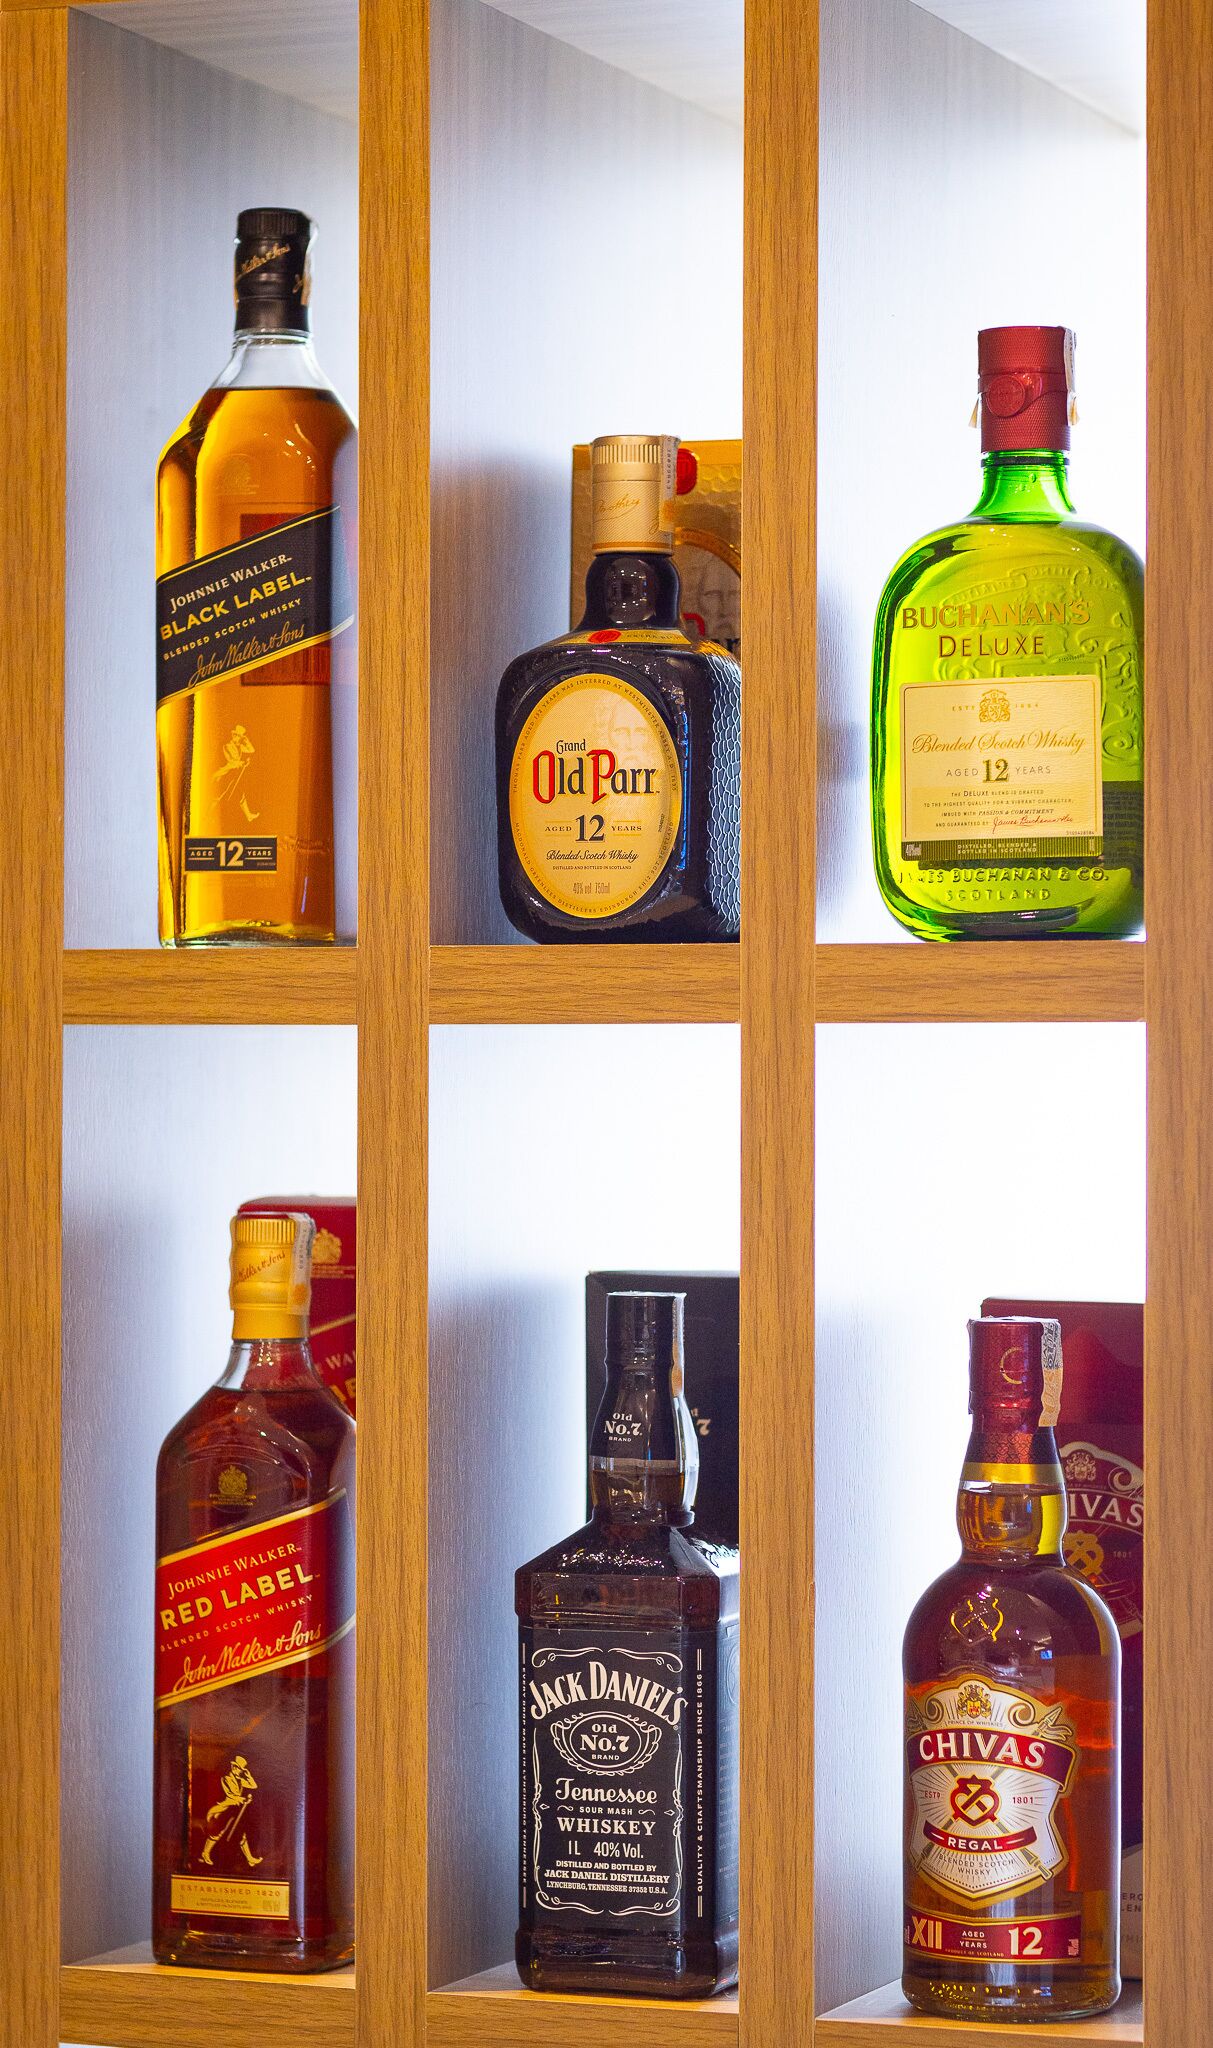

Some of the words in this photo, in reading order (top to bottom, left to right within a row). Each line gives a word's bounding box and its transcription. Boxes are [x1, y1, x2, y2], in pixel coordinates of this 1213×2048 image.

[170, 577, 231, 614] JOHNNIE
[230, 554, 288, 583] WALKER
[160, 599, 231, 640] BLACK
[233, 571, 306, 610] LABEL
[902, 600, 1092, 630] BUCHANAN'S
[163, 634, 211, 661] BLENDED
[214, 616, 256, 640] SCOTCH
[260, 598, 302, 620] WHISKY
[187, 653, 223, 688] John
[223, 637, 268, 668] Walker
[556, 739, 586, 755] Grand
[911, 733, 976, 754] Blended
[976, 731, 1026, 753] Scotch
[1027, 728, 1087, 756] Whisky
[532, 750, 586, 805] Old
[586, 749, 658, 805] Parr
[946, 768, 979, 778] AGED
[981, 758, 1010, 783] 12
[1015, 765, 1052, 775] YEARS
[574, 813, 606, 843] 12
[190, 850, 214, 858] AGED
[215, 840, 245, 867] 12
[246, 850, 272, 858] YEARS
[546, 849, 581, 861] Blended
[581, 849, 608, 861] Scotch
[608, 849, 640, 864] Whisky
[999, 847, 1037, 855] SCOTLAND
[950, 866, 1052, 884] BUCHANAN
[1076, 864, 1110, 882] CO.
[945, 888, 1051, 902] SCOTLAND
[612, 1412, 633, 1422] Old
[604, 1420, 643, 1436] No.7
[608, 1435, 633, 1443] BRAND
[1069, 1493, 1144, 1527] IVAS
[168, 1565, 232, 1601] JOHNNIE
[233, 1543, 298, 1572] WALKER
[160, 1595, 214, 1631] RED
[220, 1563, 314, 1610] LABEL
[160, 1630, 209, 1653] BLENDED
[215, 1612, 260, 1634] SCOTCH
[266, 1593, 313, 1616] WHISKY
[173, 1655, 218, 1694] John
[219, 1636, 276, 1673] Walker
[284, 1619, 322, 1652] Sons
[529, 1671, 589, 1720] JACK
[588, 1660, 689, 1727] DANIEL'S
[695, 1673, 704, 1699] 1866
[696, 1701, 704, 1736] SINCE
[947, 1719, 967, 1727] PRINCE
[591, 1723, 618, 1735] Old
[580, 1733, 630, 1753] No.7
[919, 1731, 1047, 1769] CHIVAS
[591, 1753, 621, 1761] BRAND
[555, 1777, 659, 1804] Tennessee
[696, 1738, 704, 1833] CRAFTSMANSHIP
[1012, 1796, 1035, 1805] 1801
[579, 1806, 603, 1815] SOUR
[607, 1807, 633, 1816] MASH
[556, 1817, 657, 1837] WHISKEY
[593, 1841, 621, 1858] 40%
[622, 1842, 645, 1859] Vol.
[947, 1836, 1004, 1851] REGAL
[555, 1859, 592, 1870] DISTILLED
[593, 1861, 611, 1870] AND
[612, 1862, 644, 1872] BOTTLED
[646, 1864, 658, 1872] BY
[696, 1845, 704, 1893] QUALITY
[940, 1854, 976, 1868] BLENDED
[978, 1859, 1016, 1868] SCOTCH
[543, 1869, 570, 1879] JACK
[571, 1871, 609, 1881] DANIEL
[609, 1872, 671, 1885] DISTILLERY
[957, 1867, 992, 1876] WHISKY
[180, 1884, 252, 1896] ESTABLISHED
[546, 1880, 588, 1891] LYNCHBURG,
[587, 1882, 628, 1893] TENNESSEE
[648, 1885, 669, 1895] U.S.A.
[911, 1915, 943, 1950] XII
[961, 1930, 986, 1938] AGED
[1007, 1925, 1044, 1956] 12
[959, 1939, 988, 1949] YEARS
